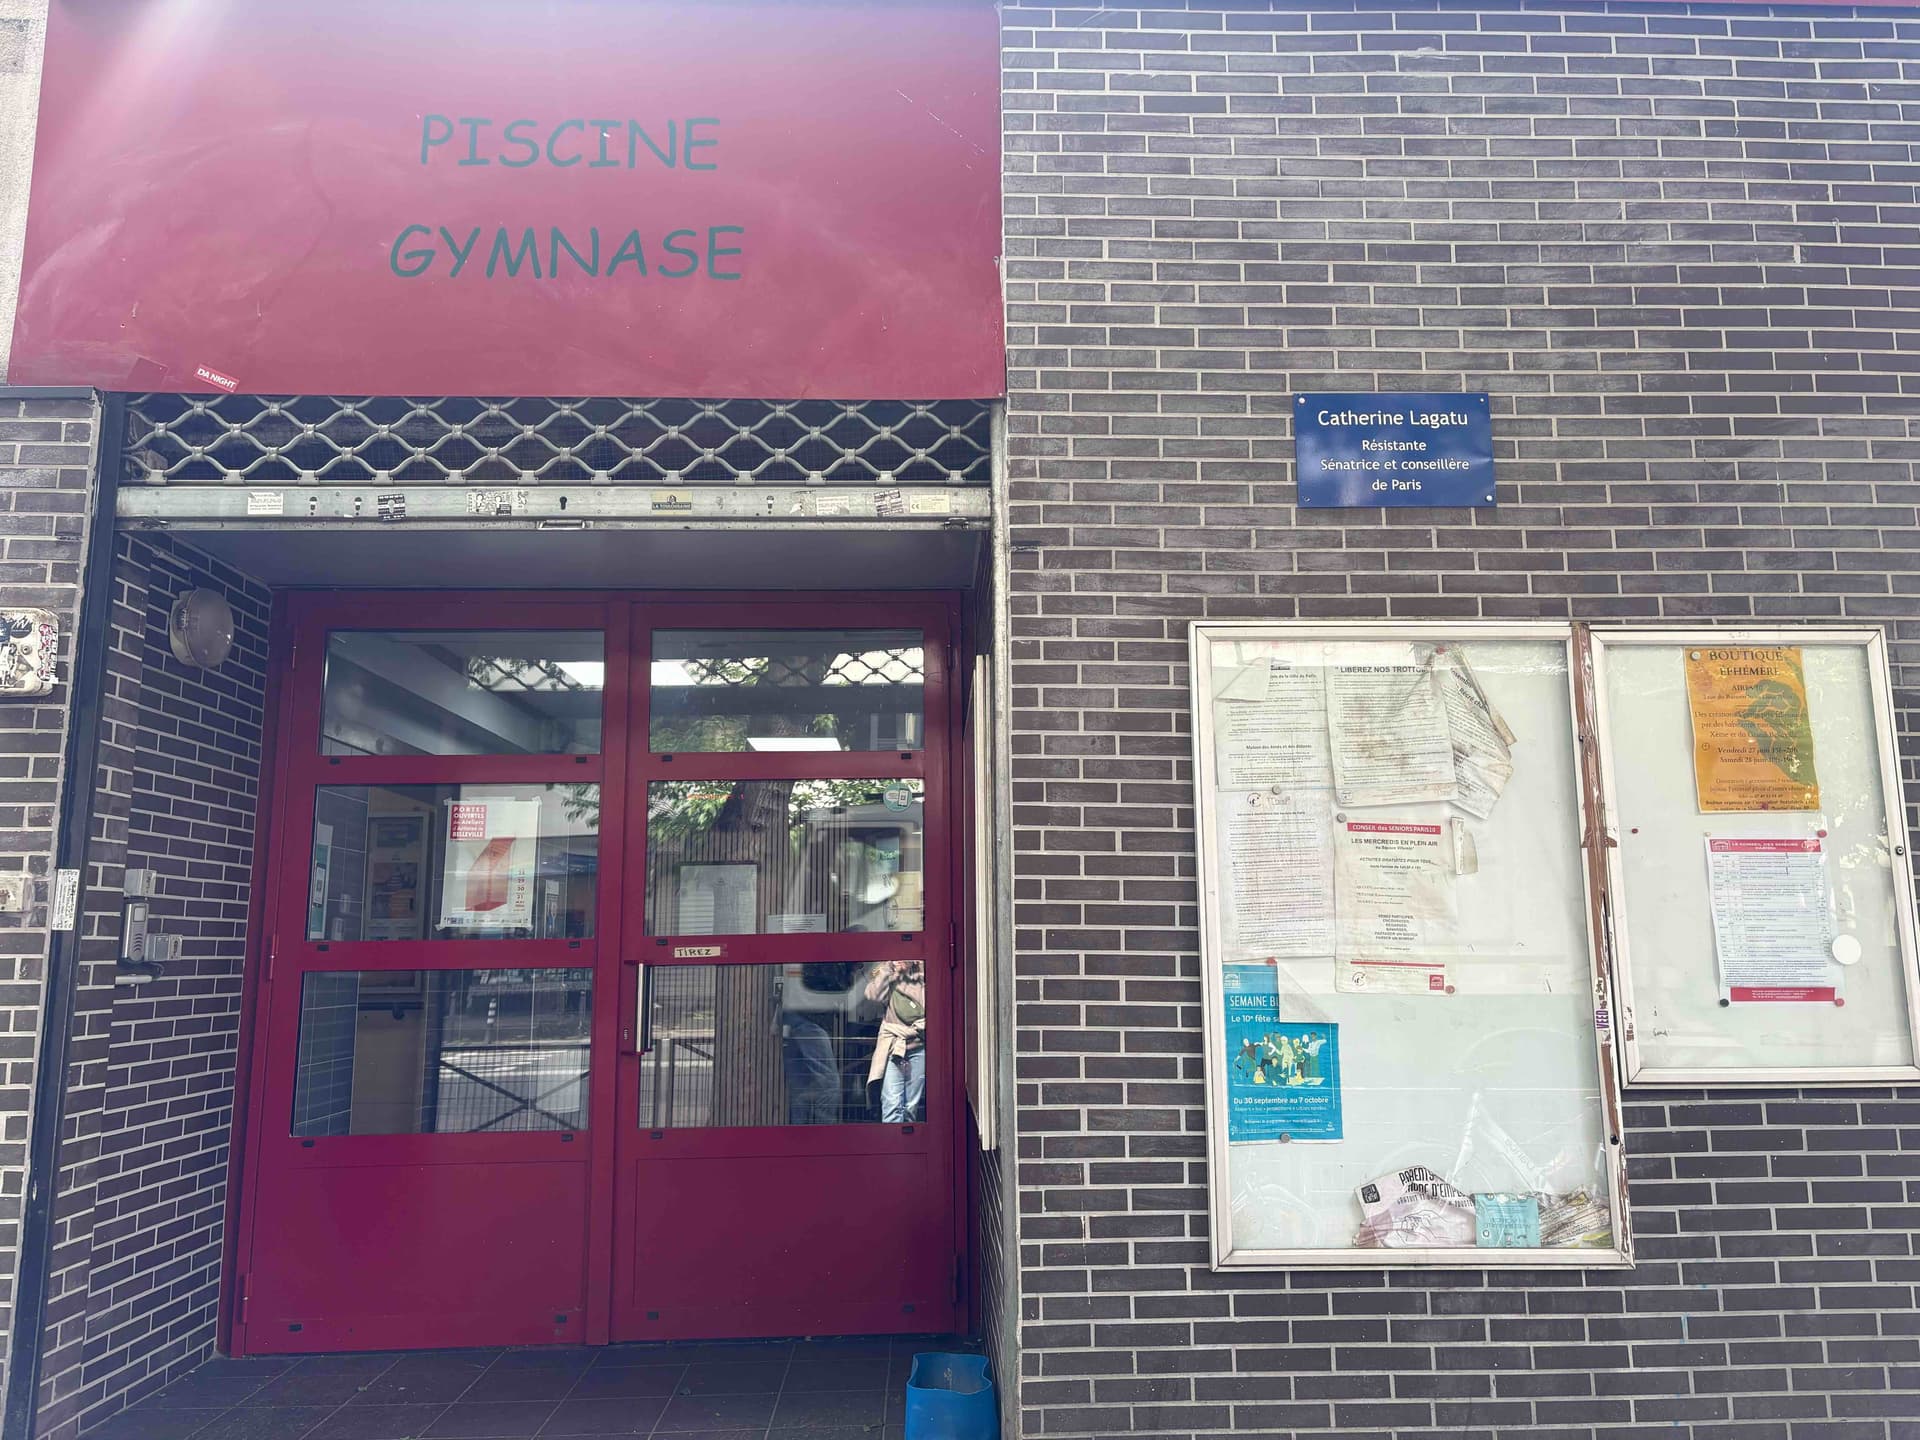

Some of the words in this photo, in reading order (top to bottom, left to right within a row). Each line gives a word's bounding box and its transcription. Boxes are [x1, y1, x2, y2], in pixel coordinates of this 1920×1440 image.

[420, 114, 721, 171] PISCINE
[390, 224, 745, 280] GYMNASE
[197, 368, 210, 378] DA
[210, 373, 236, 388] NIGHT
[1318, 410, 1404, 426] Catherine
[1410, 410, 1468, 429] Lagatu
[1362, 439, 1427, 451] Résistante
[1321, 459, 1380, 470] Sénatrice
[1384, 460, 1397, 470] et
[1401, 459, 1470, 470] conseillère
[1372, 479, 1387, 491] de
[1391, 479, 1422, 491] Paris
[1709, 650, 1784, 662] BOUTIQUE
[1230, 995, 1268, 1007] SEMAINE
[1231, 1015, 1240, 1023] Le
[1255, 1014, 1272, 1023] fête
[1254, 1097, 1288, 1105] septembre
